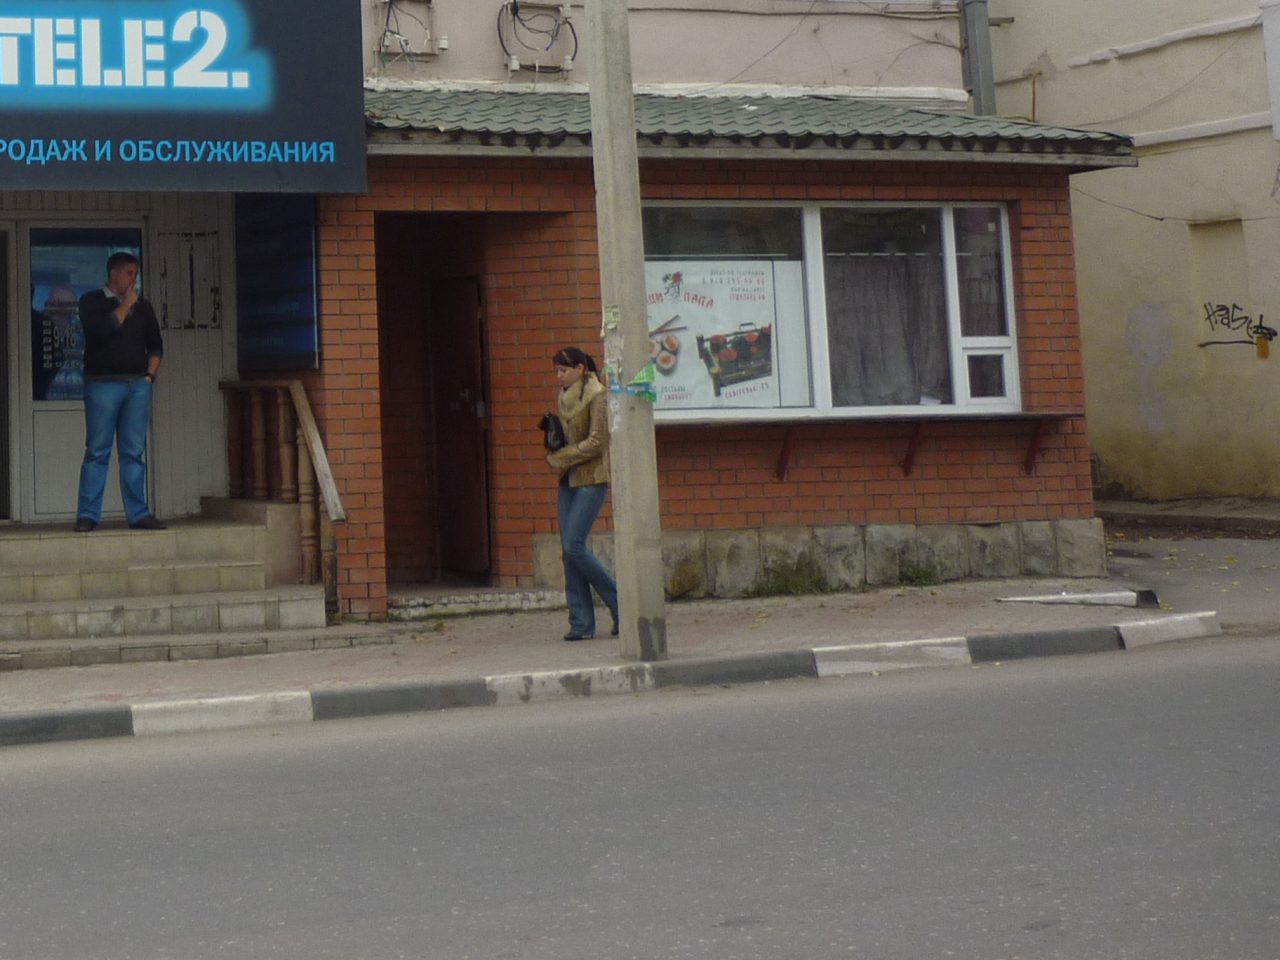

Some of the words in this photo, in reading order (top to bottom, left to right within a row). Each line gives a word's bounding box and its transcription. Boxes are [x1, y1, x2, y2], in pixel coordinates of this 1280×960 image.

[94, 139, 112, 162] И
[119, 140, 335, 163] ОБСЛУЖИВАНИЯ
[683, 292, 714, 309] ПАПА
